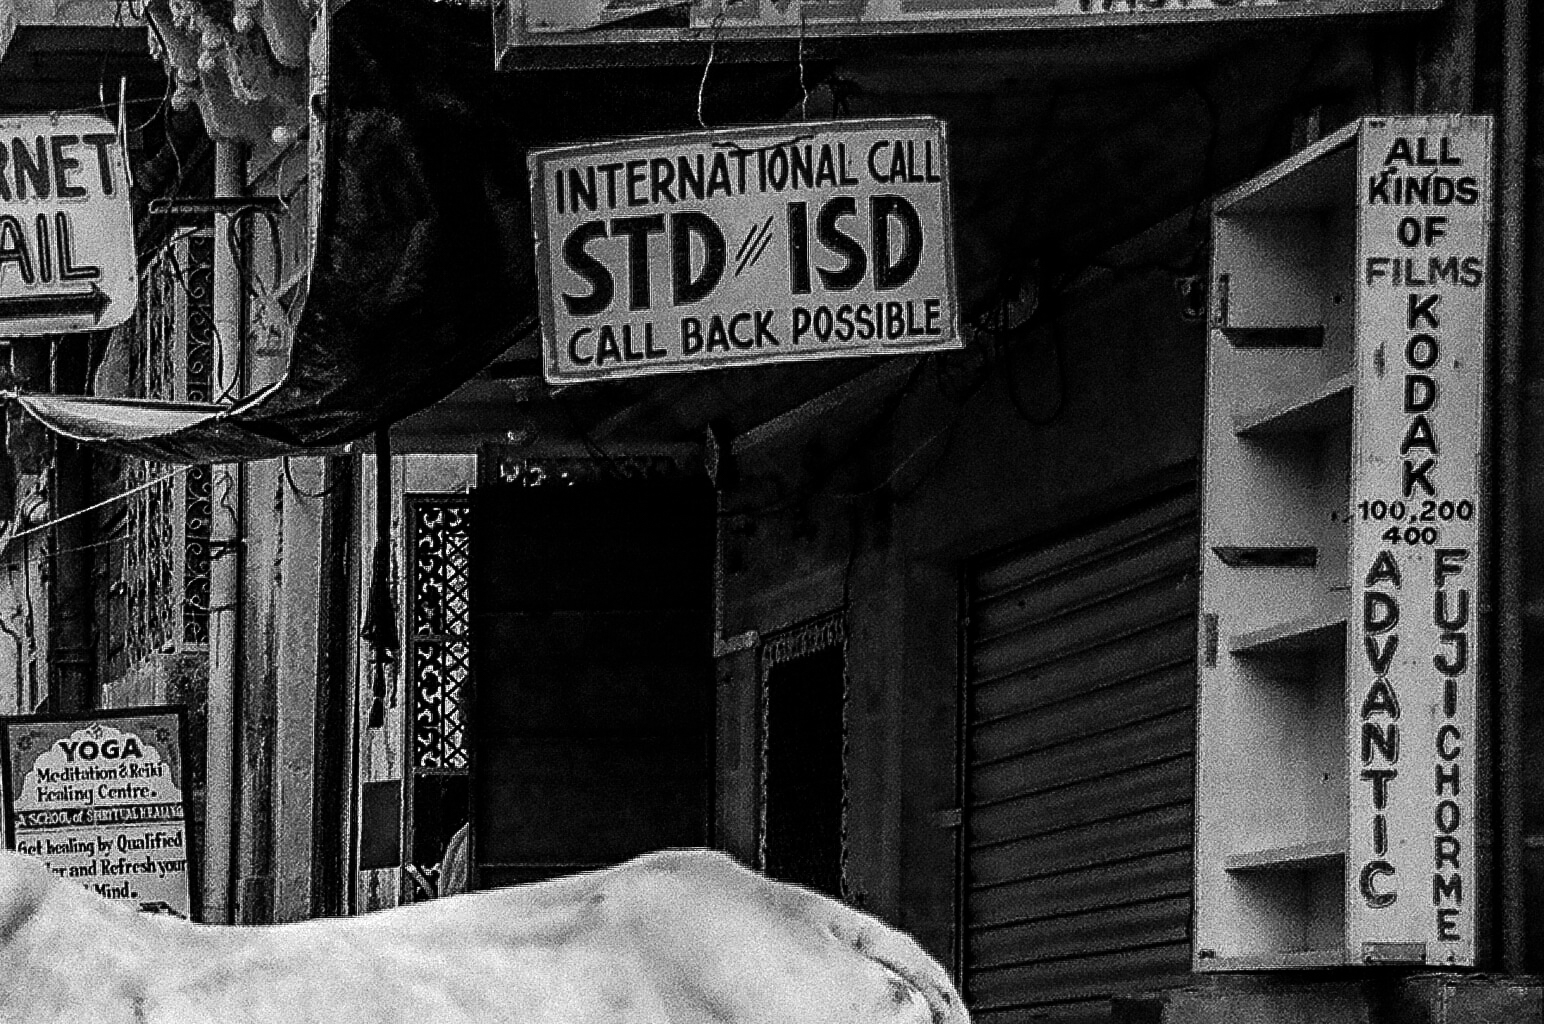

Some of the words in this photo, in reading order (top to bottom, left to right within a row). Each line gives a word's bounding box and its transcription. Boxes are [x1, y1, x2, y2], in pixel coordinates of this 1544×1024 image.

[1385, 137, 1461, 166] ALL
[556, 141, 858, 214] INTERNATIONAL
[868, 140, 941, 184] CALL
[1368, 172, 1480, 206] KINDS
[1397, 215, 1448, 248] OF
[561, 210, 727, 317] STD
[788, 194, 924, 296] ISD
[1365, 257, 1483, 288] FILMS
[568, 322, 667, 367] CALL
[680, 310, 780, 356] BACK
[792, 300, 942, 345] POSSIBLE
[1401, 294, 1441, 498] KODAK
[1382, 526, 1438, 546] 400
[1360, 550, 1402, 909] ADVANTIC
[59, 738, 143, 762] YOGA
[37, 765, 118, 784] Meditation
[130, 761, 164, 779] Reiki
[37, 784, 94, 806] Healing
[17, 840, 42, 855] Get
[47, 837, 96, 858] healing
[97, 836, 113, 857] by
[117, 829, 183, 854] Qualified
[69, 859, 97, 878] and
[100, 855, 157, 876] Refresh
[157, 860, 187, 879] your
